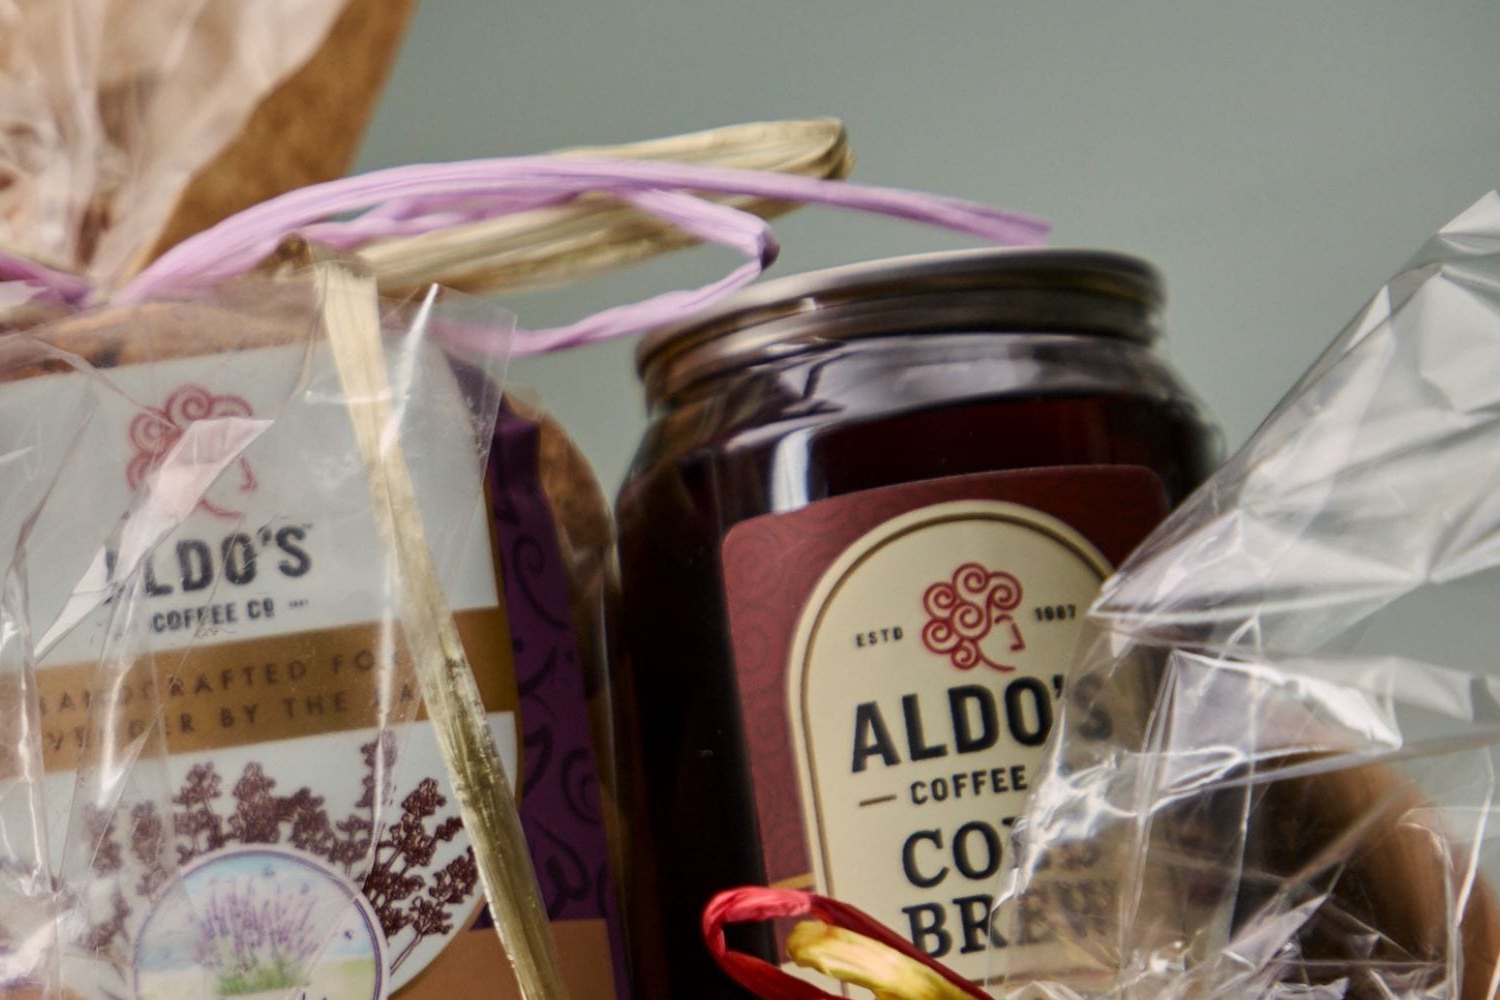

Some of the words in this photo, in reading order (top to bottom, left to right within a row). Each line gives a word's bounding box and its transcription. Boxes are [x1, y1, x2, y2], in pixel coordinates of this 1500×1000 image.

[152, 602, 238, 633] COFFEE
[855, 627, 904, 649] ESTD
[219, 702, 260, 729] BY
[283, 690, 350, 720] THE
[910, 764, 1028, 806] COFFEE
